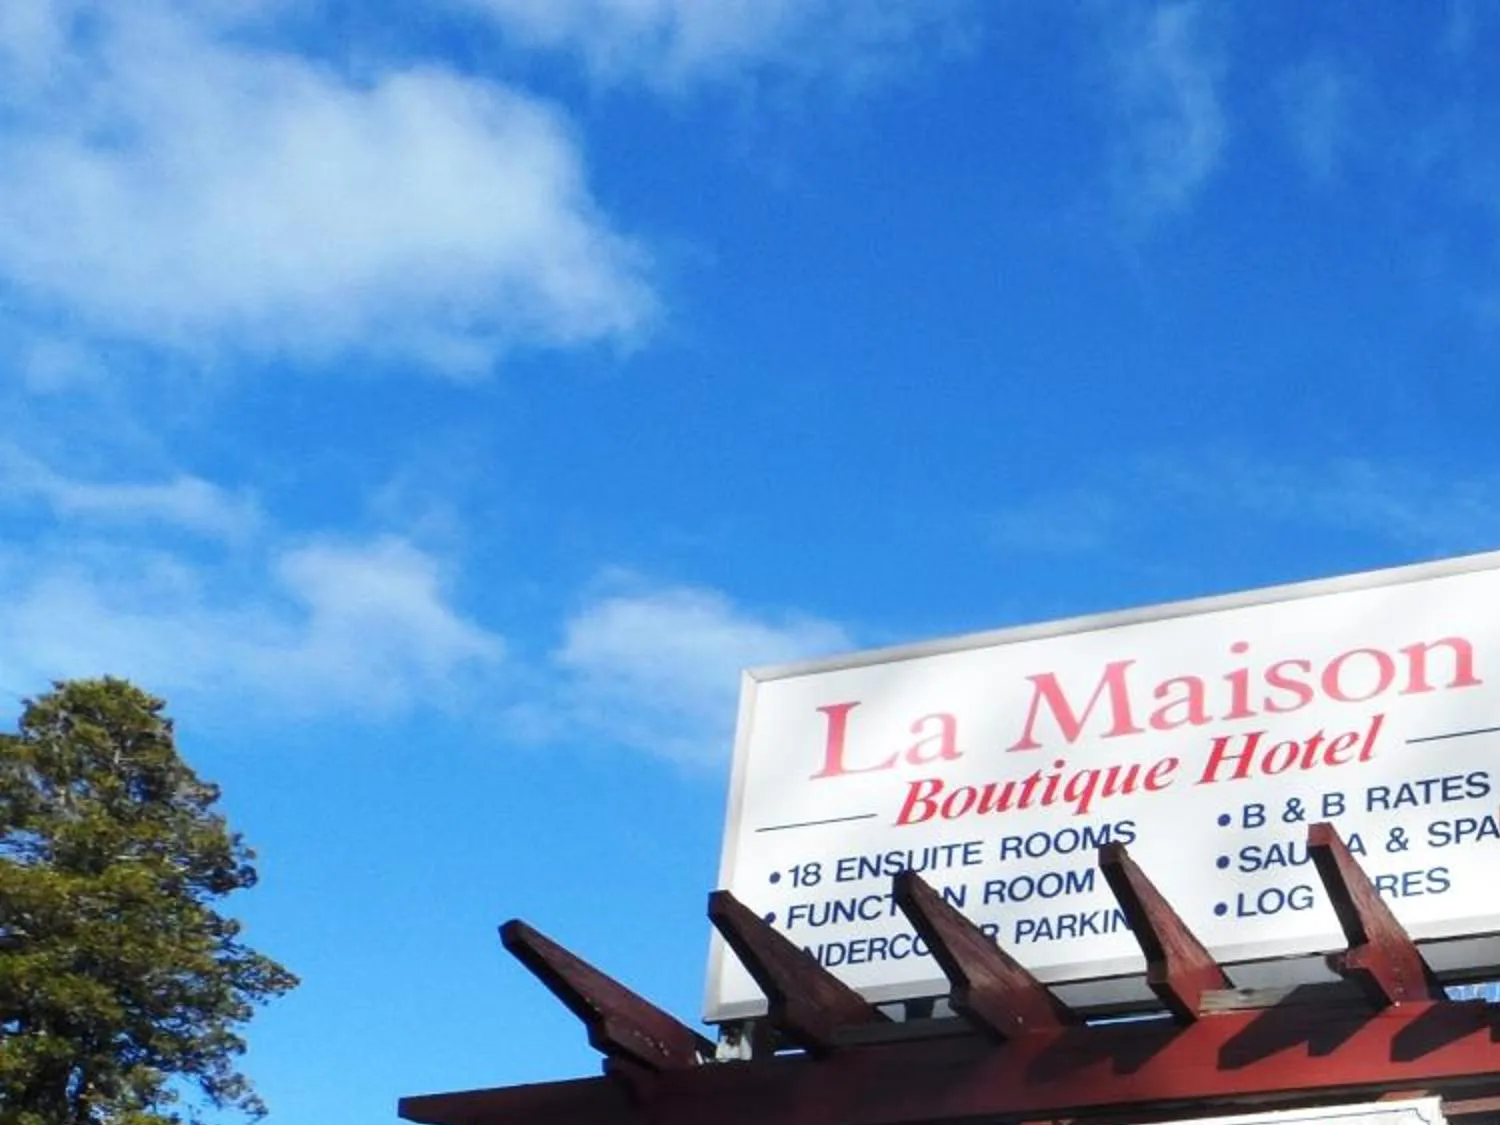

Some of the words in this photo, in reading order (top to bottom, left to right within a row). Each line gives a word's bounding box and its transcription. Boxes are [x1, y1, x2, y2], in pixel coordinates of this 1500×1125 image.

[809, 701, 962, 780] La
[1005, 636, 1483, 752] Maison
[893, 756, 1180, 827] Boutique
[1193, 713, 1385, 786] Hotel
[1242, 804, 1266, 829] B
[1281, 797, 1305, 824] &
[1322, 792, 1345, 818] B
[1366, 771, 1491, 812] RATES
[788, 863, 822, 888] 18
[836, 841, 983, 883] ENSUITE
[1001, 820, 1136, 860] ROOMS
[1239, 832, 1367, 872] SAUA
[1386, 827, 1409, 853] &
[1428, 815, 1500, 848] SPA
[787, 884, 967, 930] FUNCTN
[983, 867, 1095, 904] ROOM
[1237, 885, 1314, 917] LOG
[1375, 867, 1450, 900] RES
[1015, 908, 1132, 944] PARKIN
